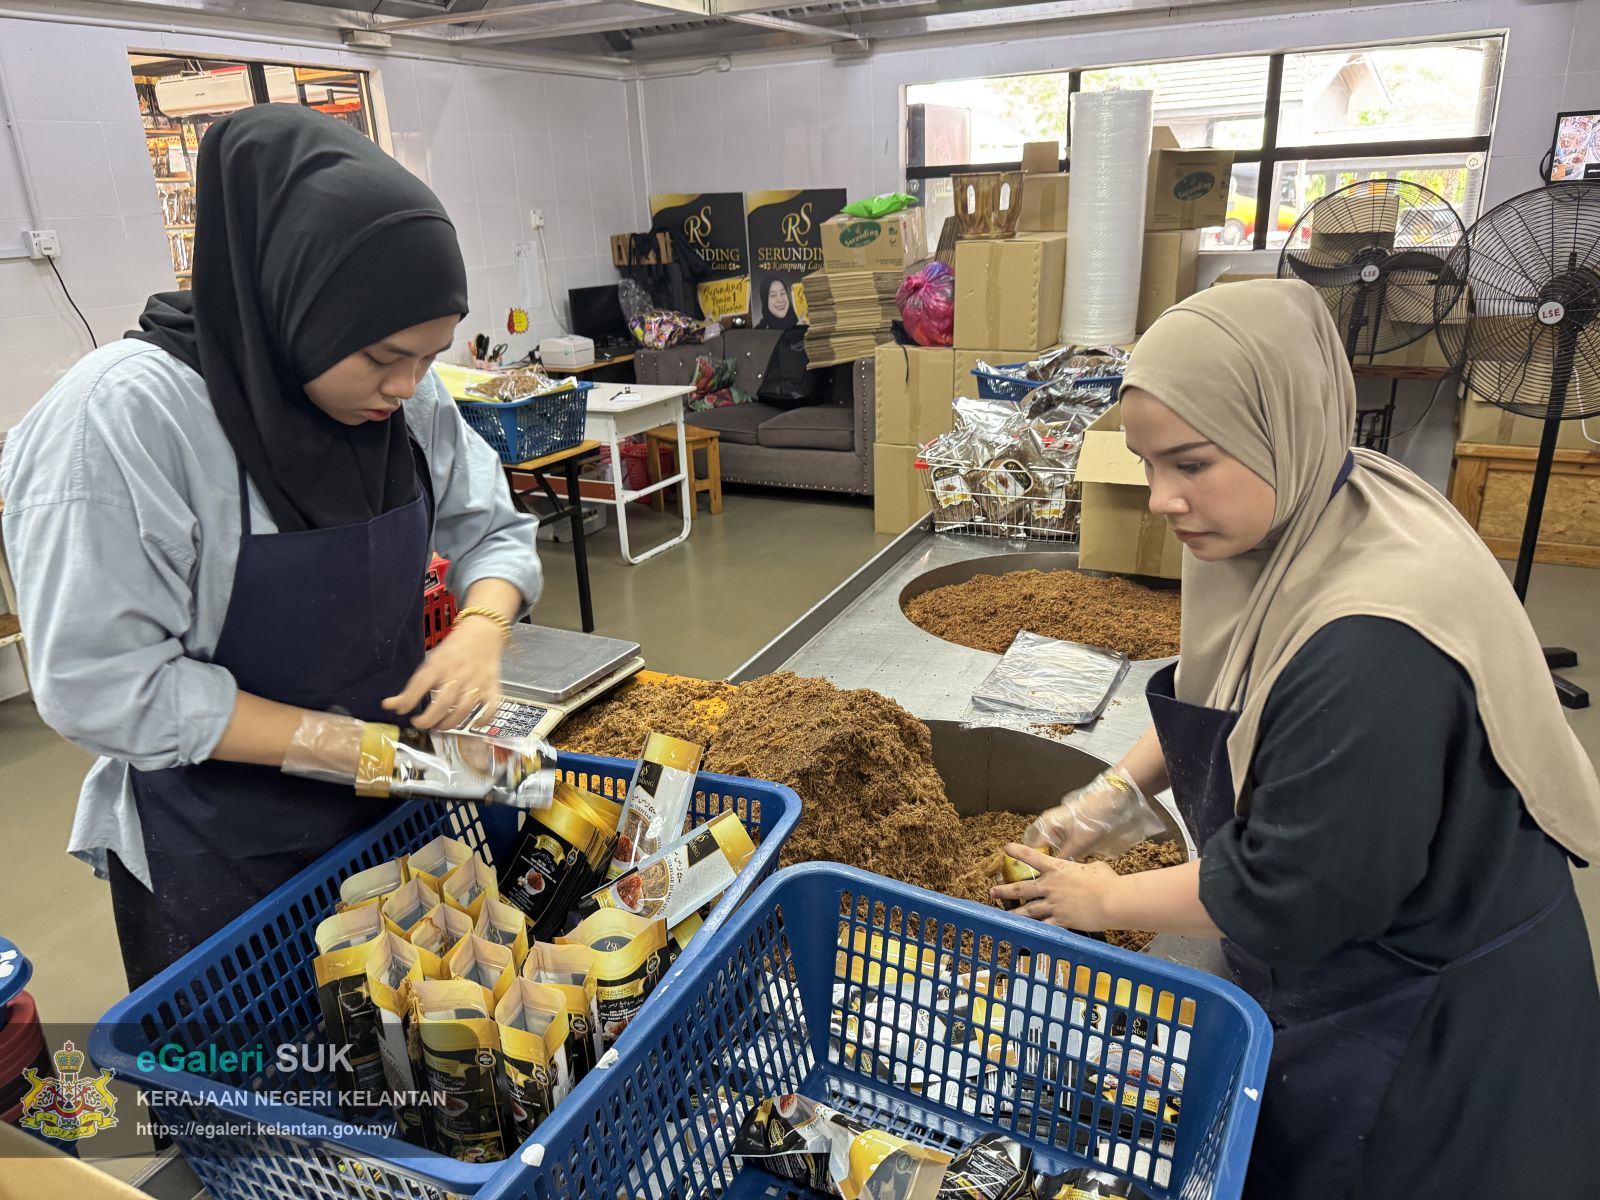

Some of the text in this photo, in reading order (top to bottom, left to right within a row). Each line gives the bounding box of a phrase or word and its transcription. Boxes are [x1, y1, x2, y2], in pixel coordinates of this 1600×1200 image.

[684, 205, 711, 248] RS
[781, 202, 812, 246] RS
[695, 248, 740, 261] NDING
[758, 247, 823, 261] SERUNDI
[808, 261, 823, 270] Lau
[1363, 270, 1376, 278] LSE
[1542, 308, 1560, 319] LSE
